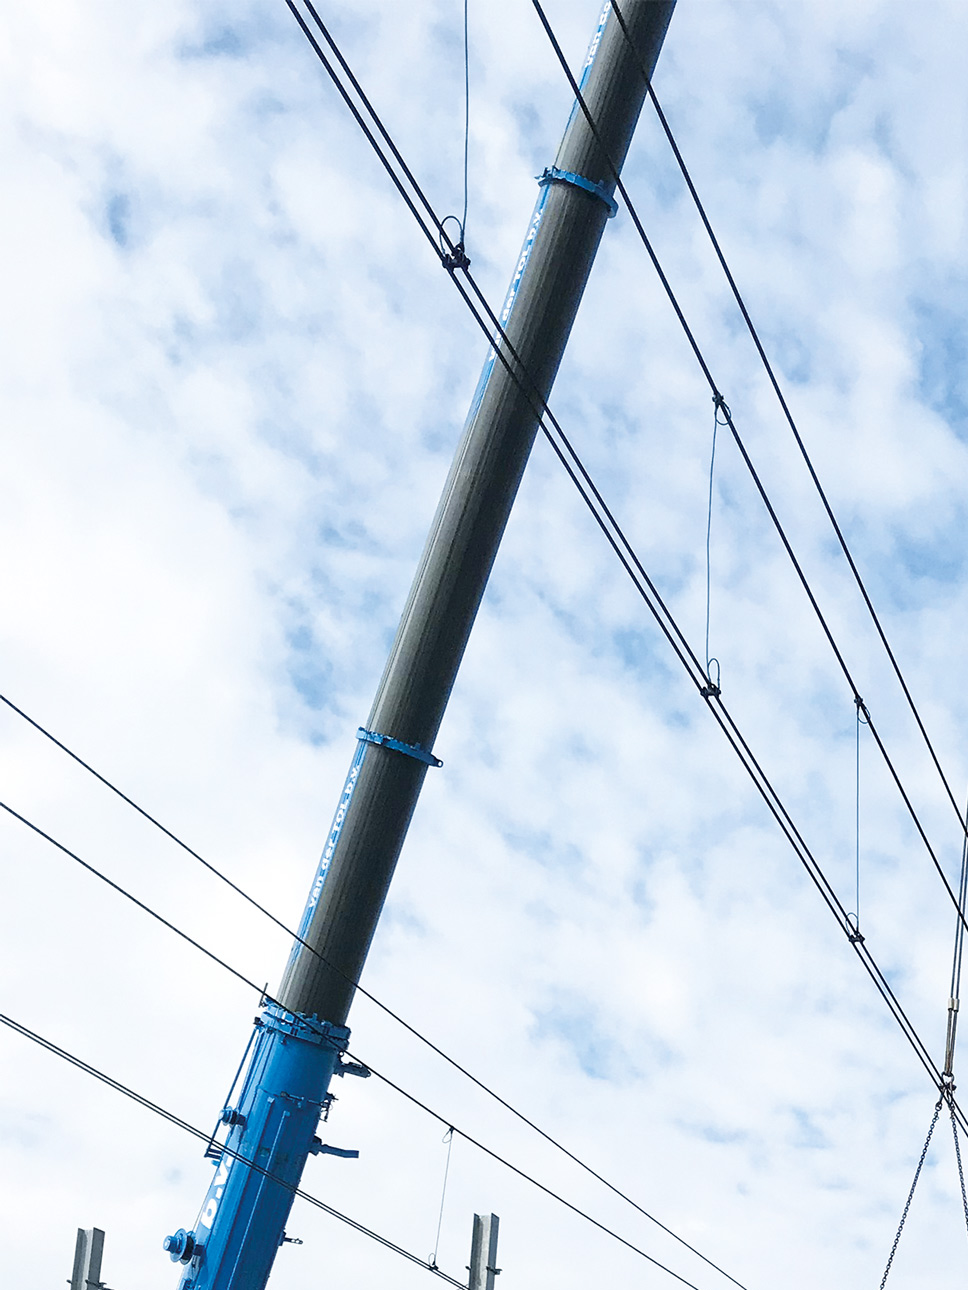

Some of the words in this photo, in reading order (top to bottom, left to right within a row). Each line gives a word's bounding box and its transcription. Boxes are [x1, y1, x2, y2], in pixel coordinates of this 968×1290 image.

[513, 245, 532, 284] TOL
[309, 874, 324, 908] van
[321, 839, 336, 871] der
[331, 798, 350, 833] TOL
